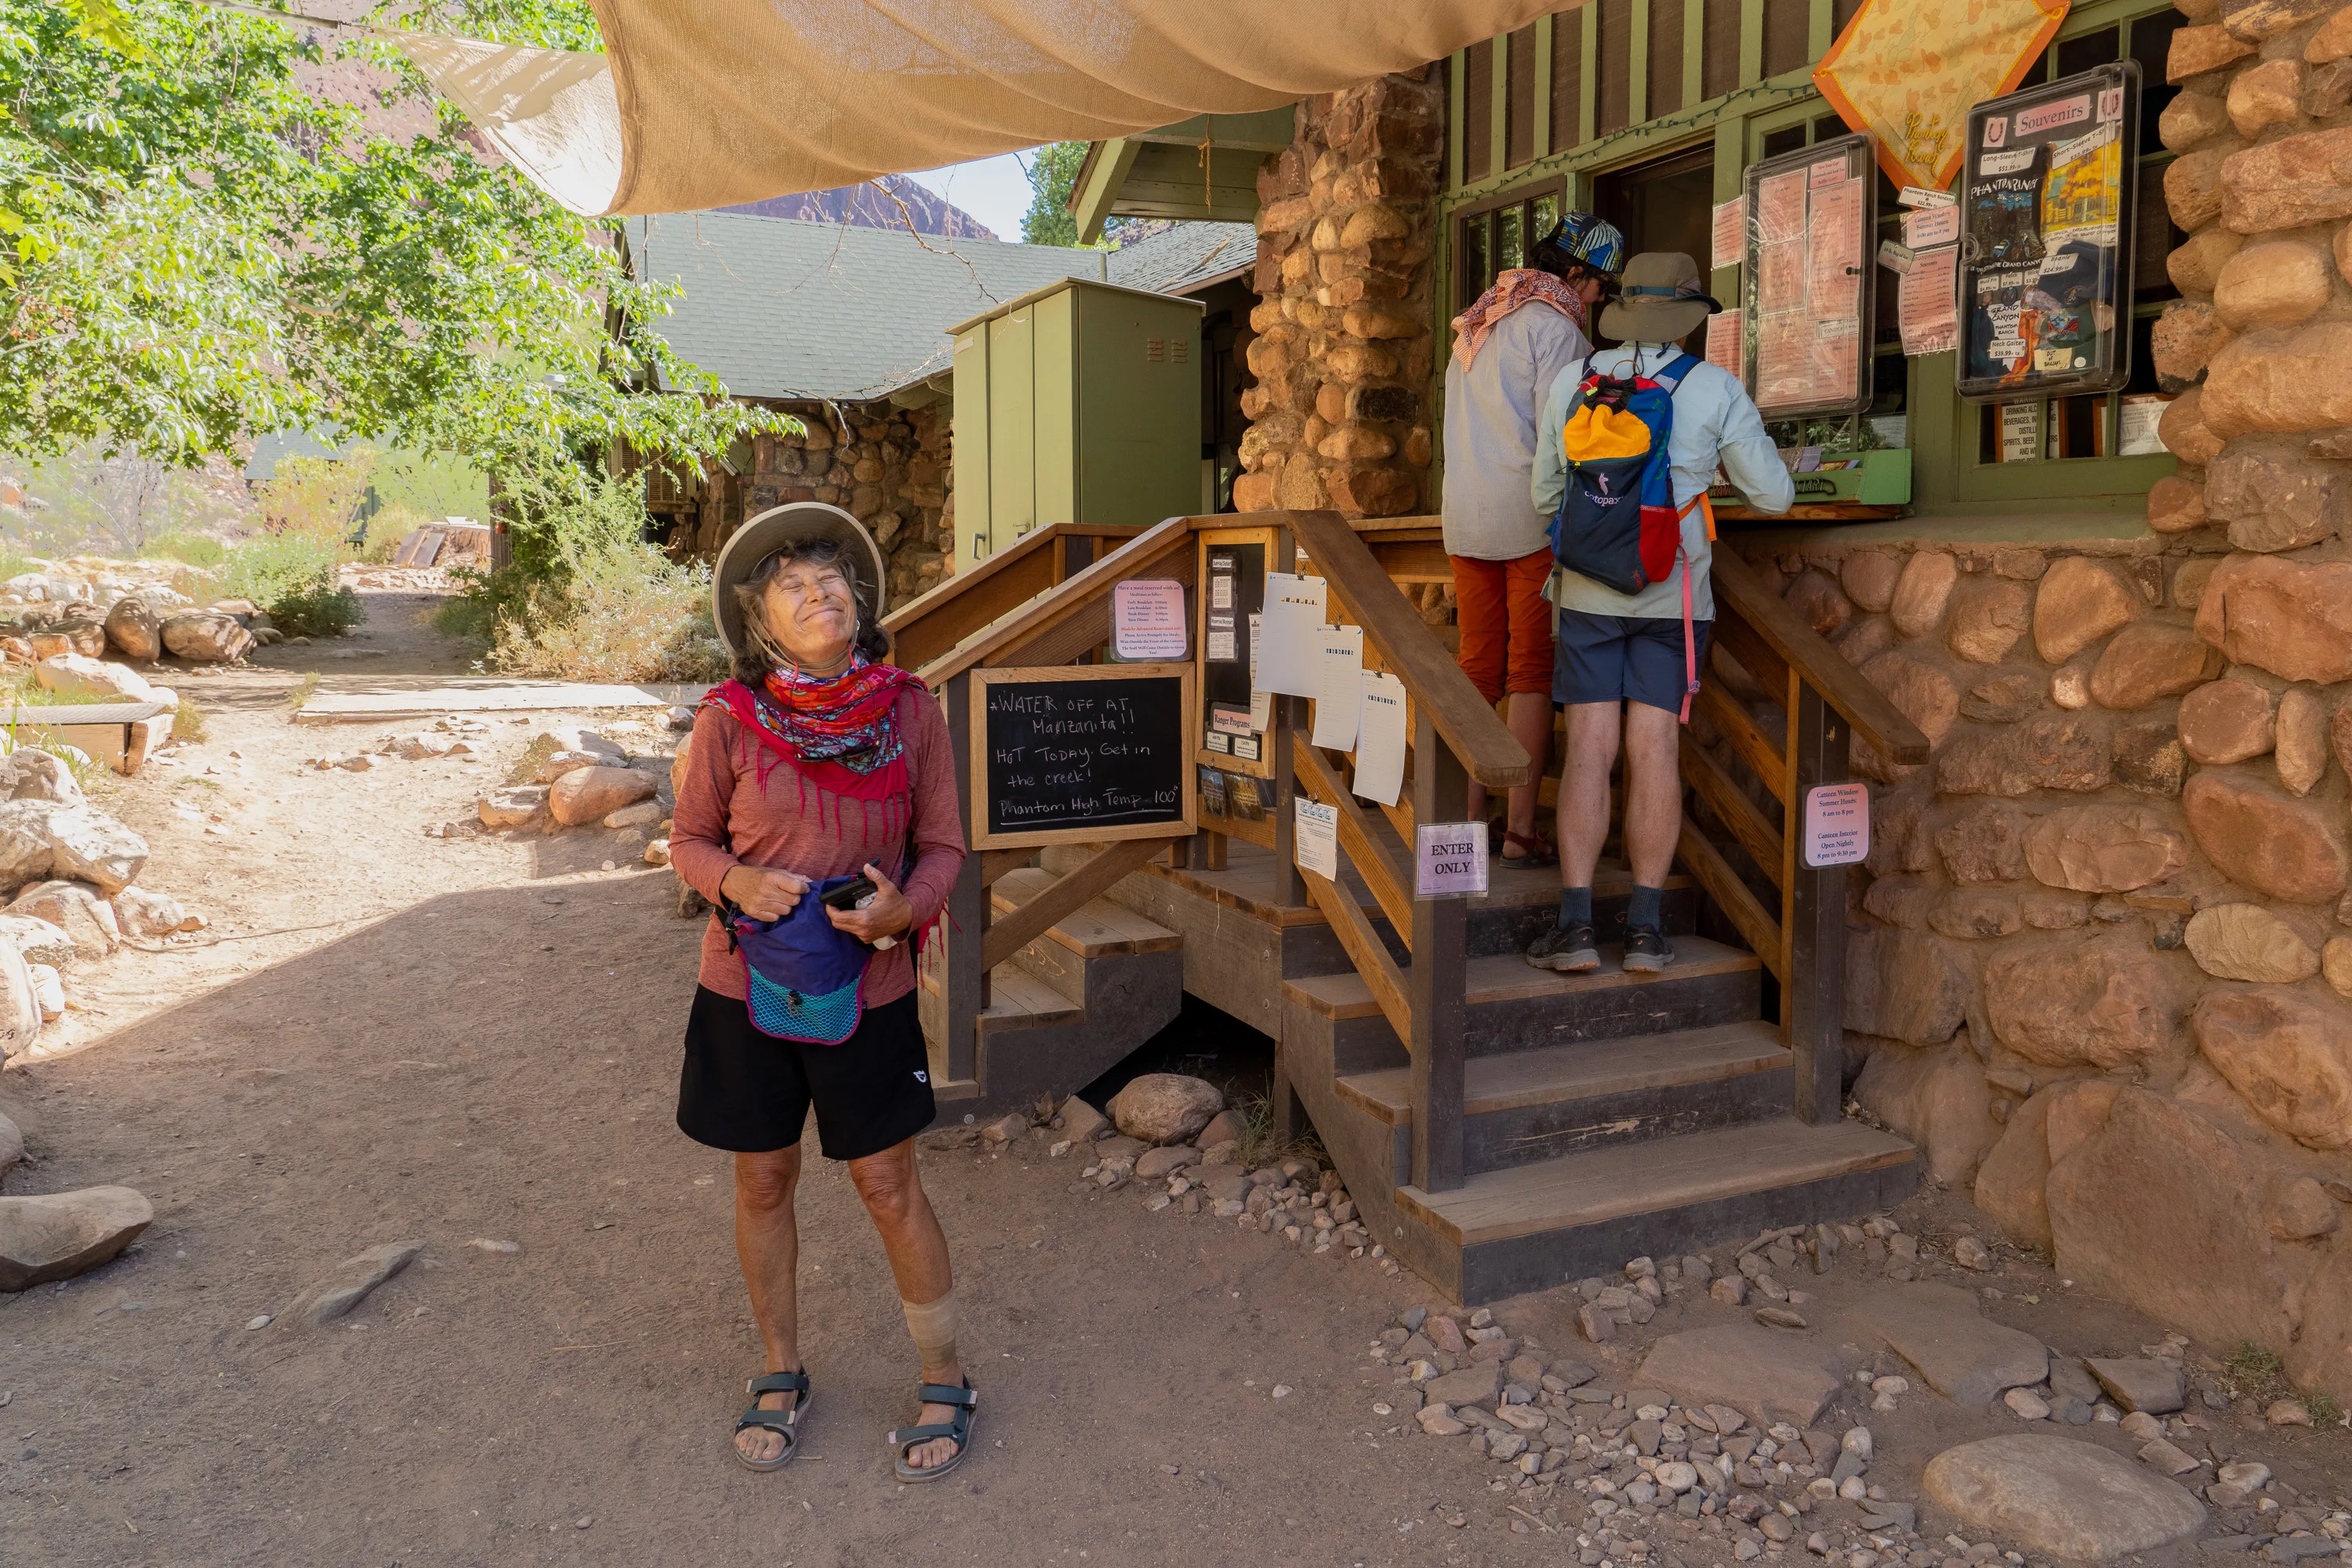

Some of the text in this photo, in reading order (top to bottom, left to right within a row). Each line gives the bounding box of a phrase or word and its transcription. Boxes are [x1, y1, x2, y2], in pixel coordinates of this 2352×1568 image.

[2021, 105, 2083, 132] Souvenirs
[2053, 136, 2091, 158] Short-Sleeve
[1983, 149, 2034, 162] Long-Sleeve T-Shirt
[1933, 211, 1951, 220] Window
[1991, 304, 2020, 314] GRAND
[2006, 407, 2027, 416] DRINKING
[1584, 491, 1623, 506] cotopax
[1068, 699, 1094, 712] OFF
[1106, 698, 1129, 711] AT
[1214, 713, 1250, 728] Ranger Programs
[1100, 743, 1129, 757] Get
[1135, 745, 1151, 756] in
[1007, 769, 1092, 788] the creek!
[1000, 800, 1065, 818] Phantom
[1072, 798, 1099, 817] High
[1431, 842, 1474, 856] ENTER
[1435, 862, 1471, 875] ONLY
